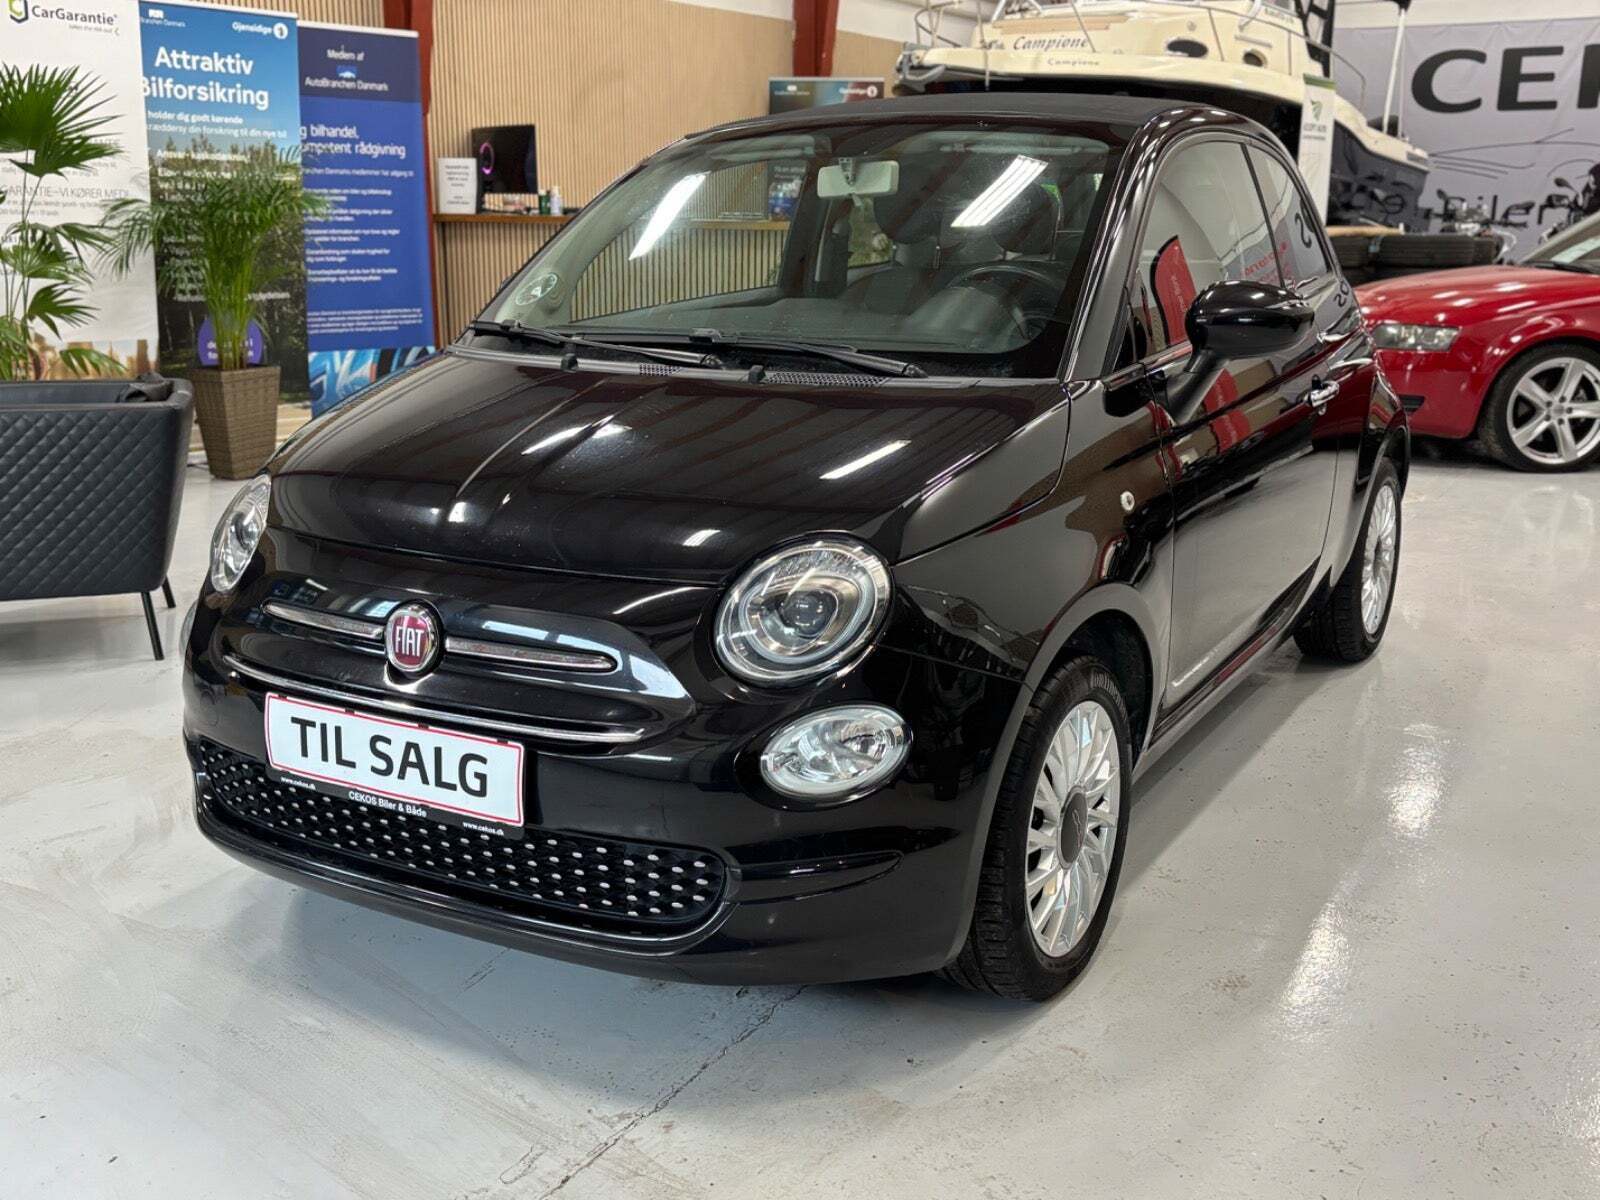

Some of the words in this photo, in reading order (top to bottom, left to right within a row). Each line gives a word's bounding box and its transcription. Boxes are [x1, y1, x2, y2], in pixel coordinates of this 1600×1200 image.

[31, 5, 115, 25] CarGarantie
[232, 21, 272, 34] Gjensidige
[1013, 35, 1089, 51] Campione
[154, 46, 254, 75] Attraktiv
[1411, 43, 1600, 114] CE
[395, 625, 424, 657] FIAT
[290, 716, 357, 769] TIL
[369, 734, 488, 798] SALG
[348, 790, 377, 806] CEKOS
[378, 798, 397, 810] Biler
[398, 803, 405, 813] &
[405, 805, 427, 818] Både
